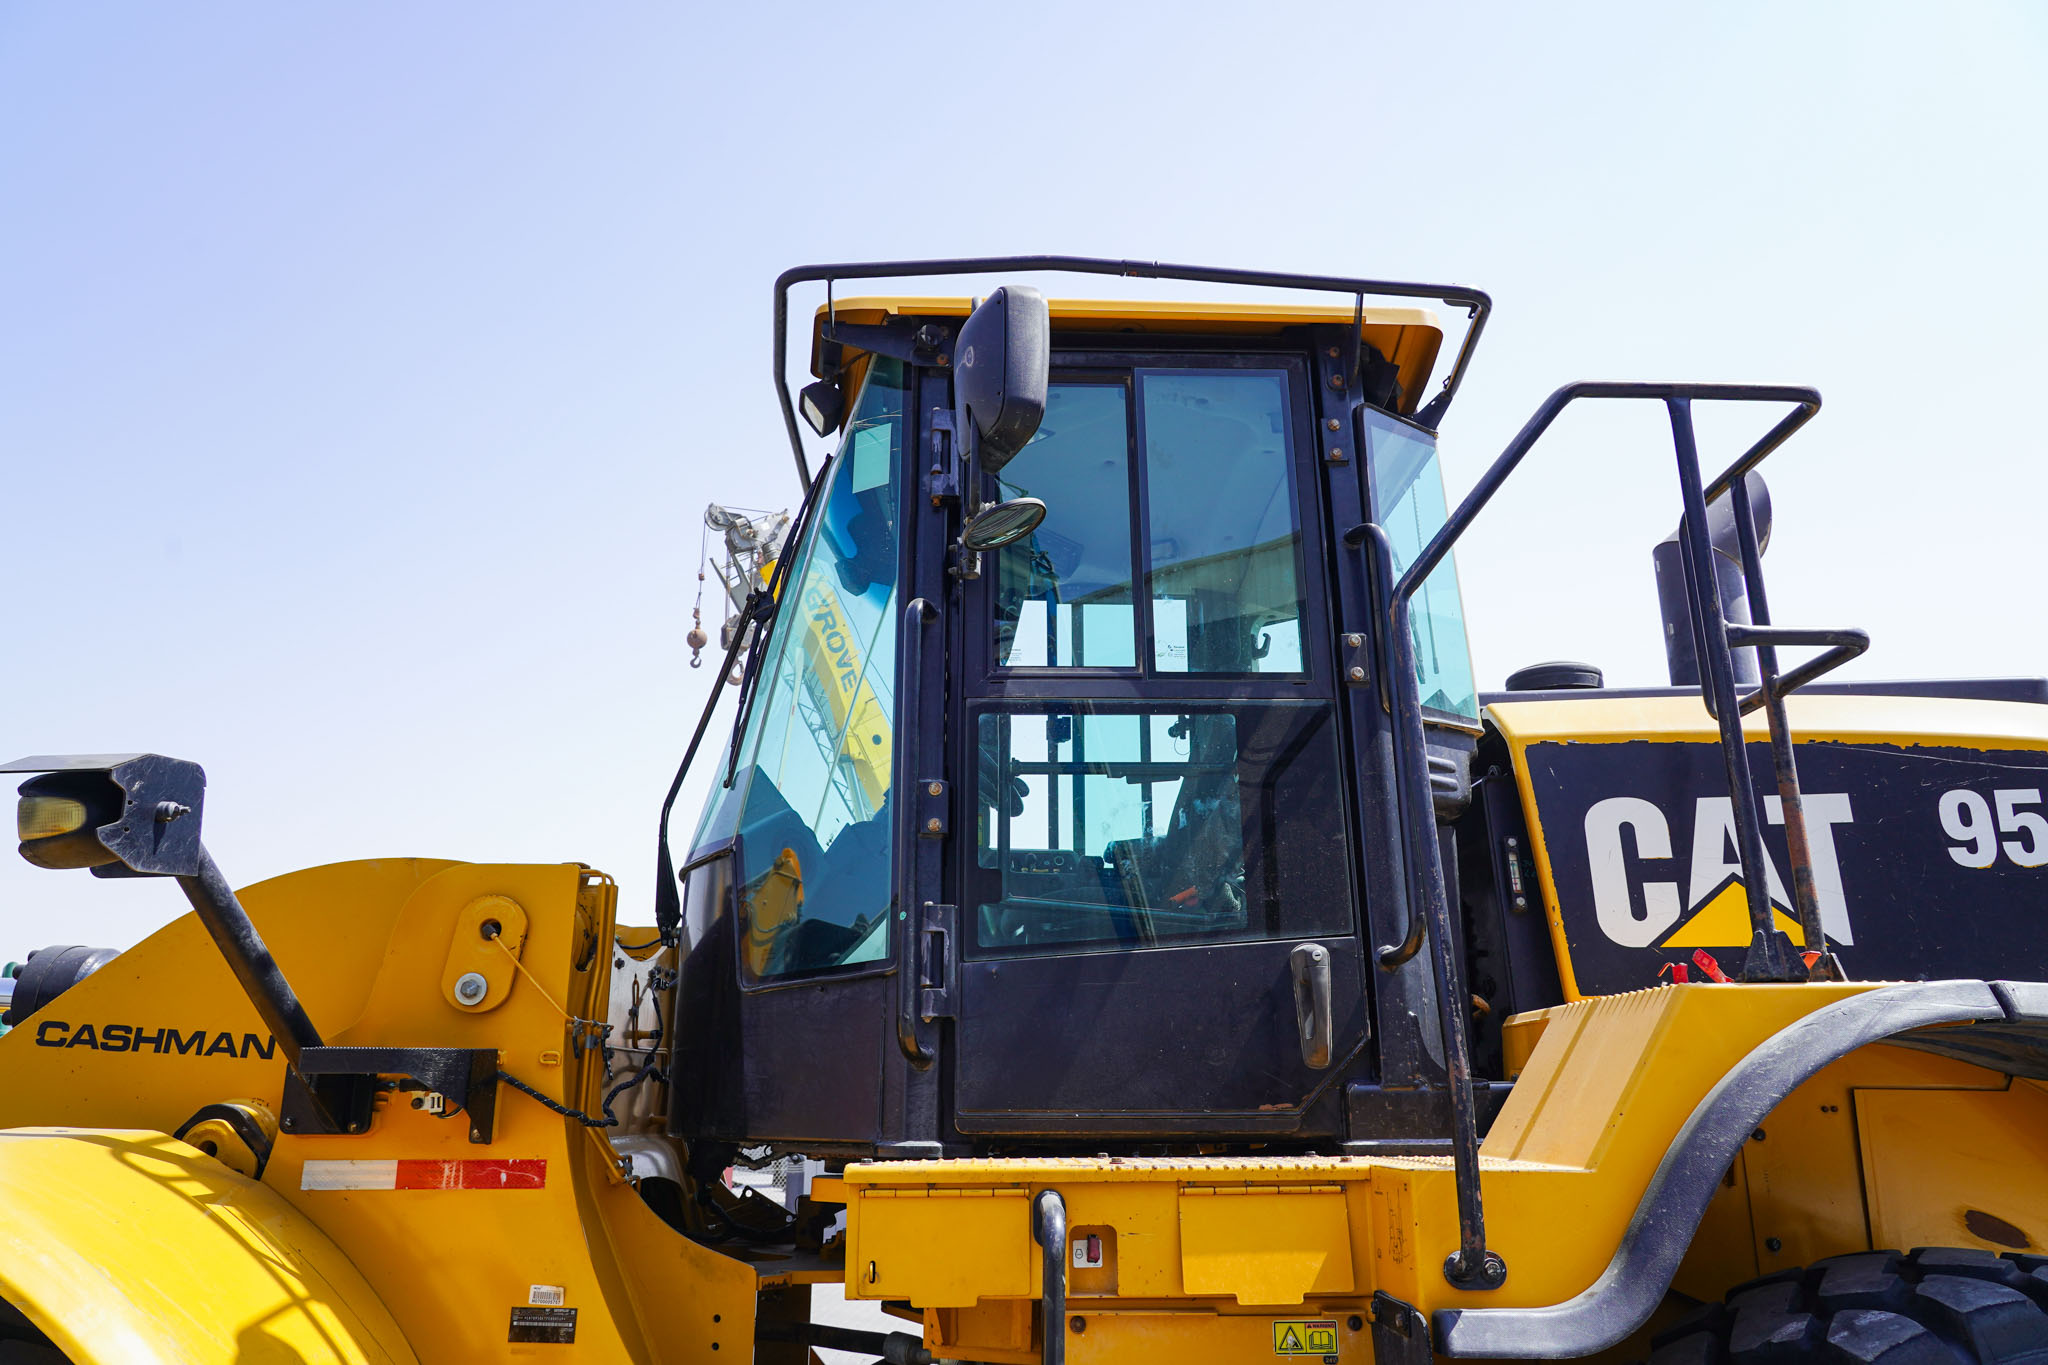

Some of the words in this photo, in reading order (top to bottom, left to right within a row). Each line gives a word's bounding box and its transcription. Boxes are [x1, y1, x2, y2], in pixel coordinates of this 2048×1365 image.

[805, 586, 858, 693] GROVE
[1584, 793, 1854, 948] CAT
[1938, 788, 2048, 869] 95
[35, 1020, 276, 1060] CASHMAN
